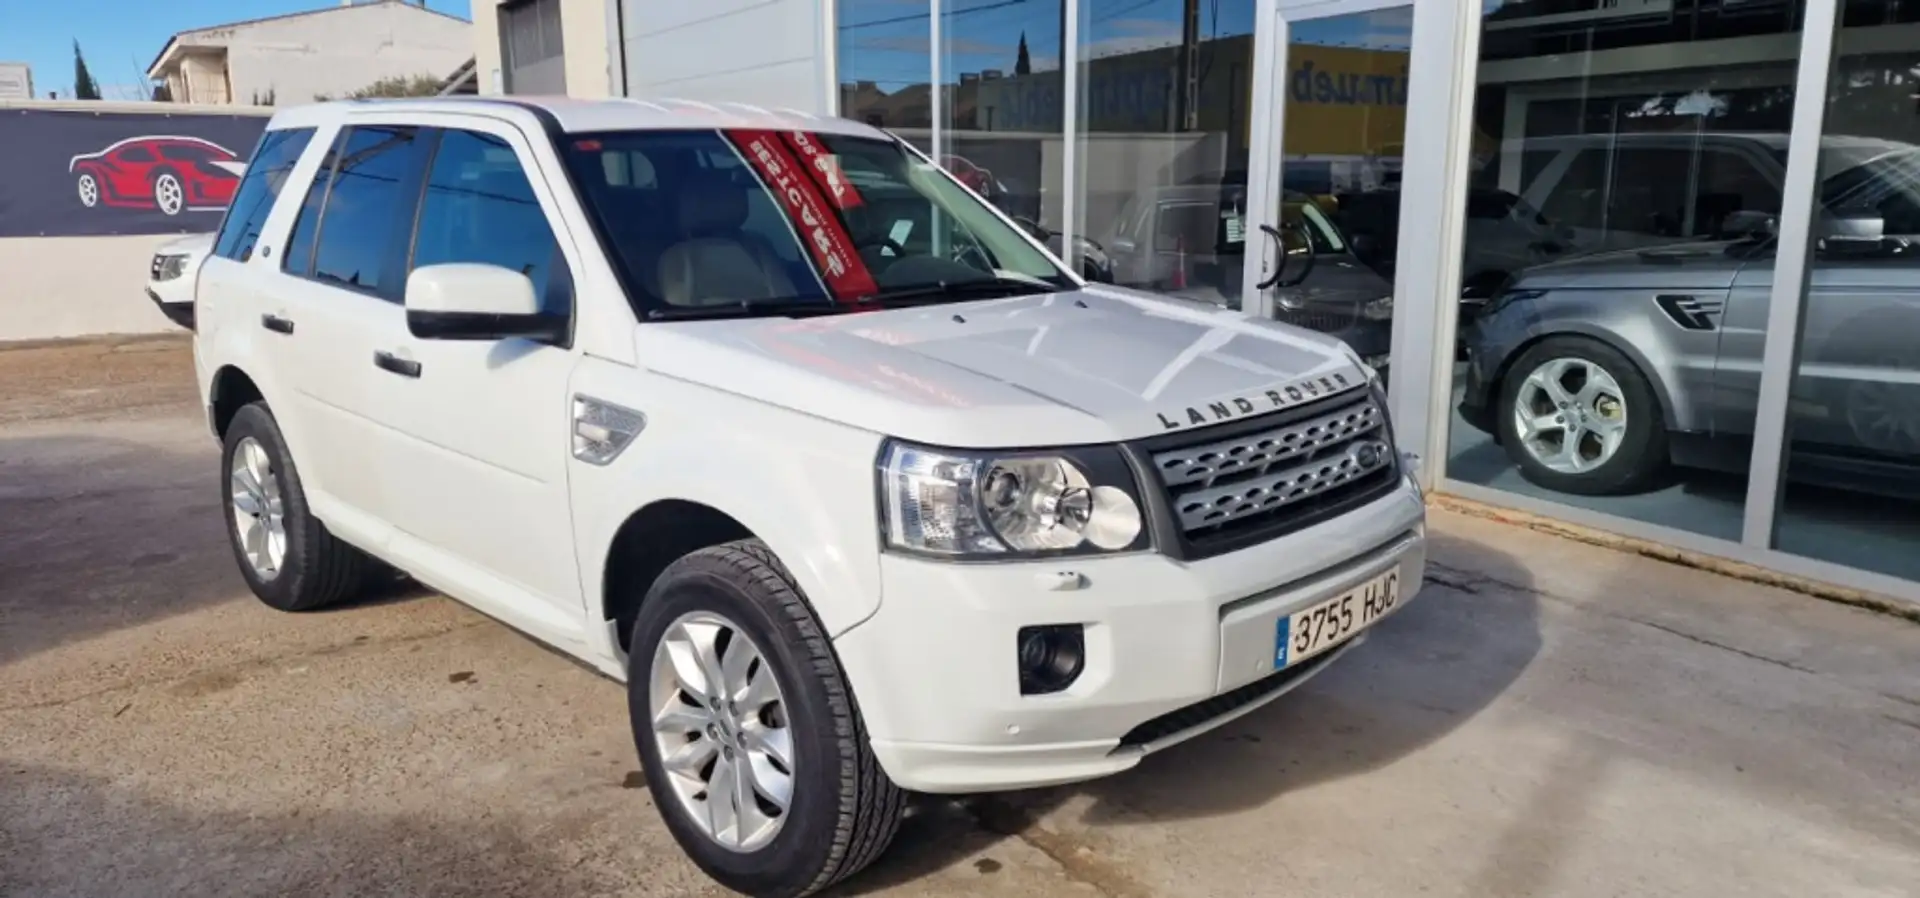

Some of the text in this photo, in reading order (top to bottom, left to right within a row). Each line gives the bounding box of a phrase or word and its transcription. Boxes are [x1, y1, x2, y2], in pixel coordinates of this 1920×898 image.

[1156, 372, 1349, 430] LAND ROVER
[1296, 572, 1397, 653] 3755 HJC
